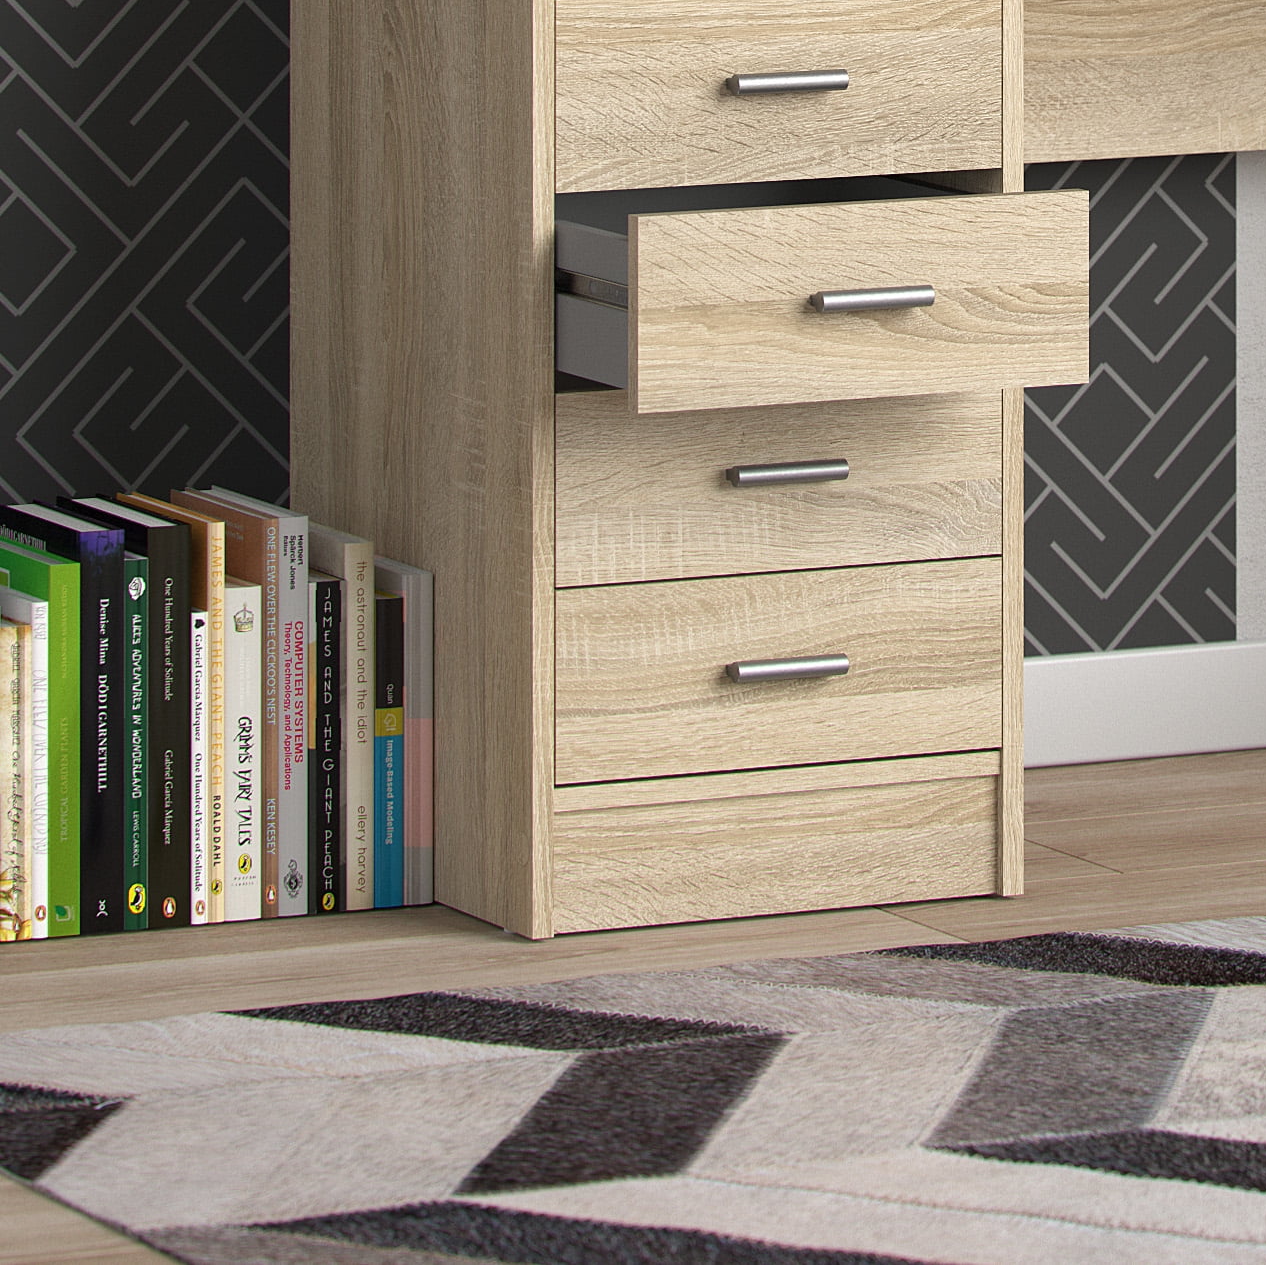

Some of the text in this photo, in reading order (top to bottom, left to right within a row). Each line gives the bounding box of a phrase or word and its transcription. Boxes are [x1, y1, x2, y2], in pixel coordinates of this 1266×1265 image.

[289, 566, 297, 590] Jones
[98, 598, 110, 664] Denise Mina
[164, 578, 174, 701] One Hundred Years of Solitude
[194, 634, 204, 668] Gabriel
[266, 527, 276, 726] ONE FLEW OVER THE CUCKOO'S NEST
[356, 561, 368, 744] the astronaut and the idiot
[98, 674, 110, 702] DÖD
[132, 649, 143, 710] ADVENTURES
[210, 536, 223, 786] JAMES AND THE GIANT PEACH
[294, 621, 304, 763] COMPUTER SYSTEMS
[386, 684, 394, 704] Quan
[132, 715, 142, 725] IN
[192, 702, 204, 742] Márquez
[282, 622, 292, 790] Theory, Technology, and Applications
[322, 588, 334, 890] JAMES AND THE GIANT PEACH
[97, 712, 108, 793] GARNETHILL
[132, 728, 142, 799] WONDERLAND
[164, 750, 174, 780] Gabriel
[232, 770, 254, 802] FAIRY
[384, 740, 394, 845] Image-Based Modeling
[132, 810, 140, 867] LEWIS CARROLL
[162, 809, 174, 844] Márquez
[194, 753, 204, 892] One Hundred Years of Solitude
[212, 795, 222, 867] ROALD DAHL
[235, 806, 253, 846] TALES
[266, 798, 276, 855] KEN KESEY
[354, 806, 368, 894] ellery harvey
